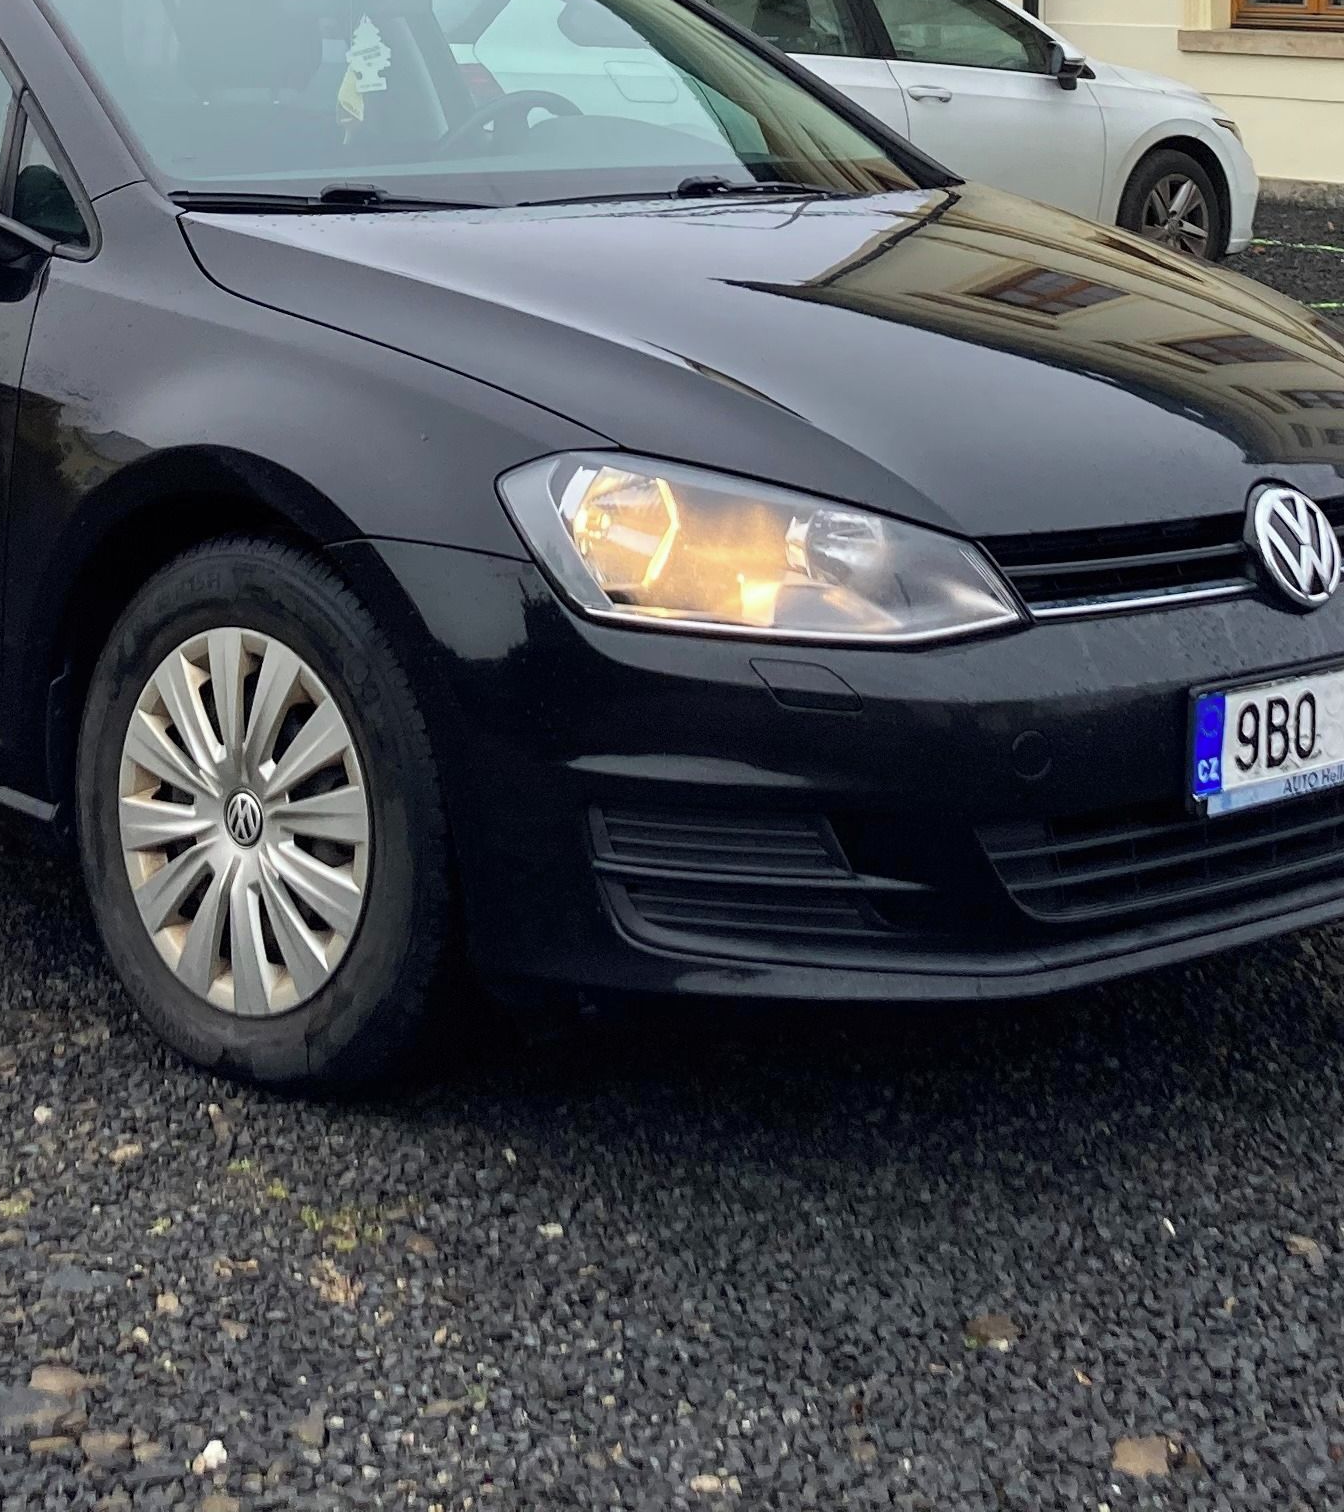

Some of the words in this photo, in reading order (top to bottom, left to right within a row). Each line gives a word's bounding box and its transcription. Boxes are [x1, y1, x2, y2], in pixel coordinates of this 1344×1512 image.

[1255, 487, 1341, 601] VW
[1197, 756, 1220, 784] CZ
[1282, 771, 1318, 794] AUTO
